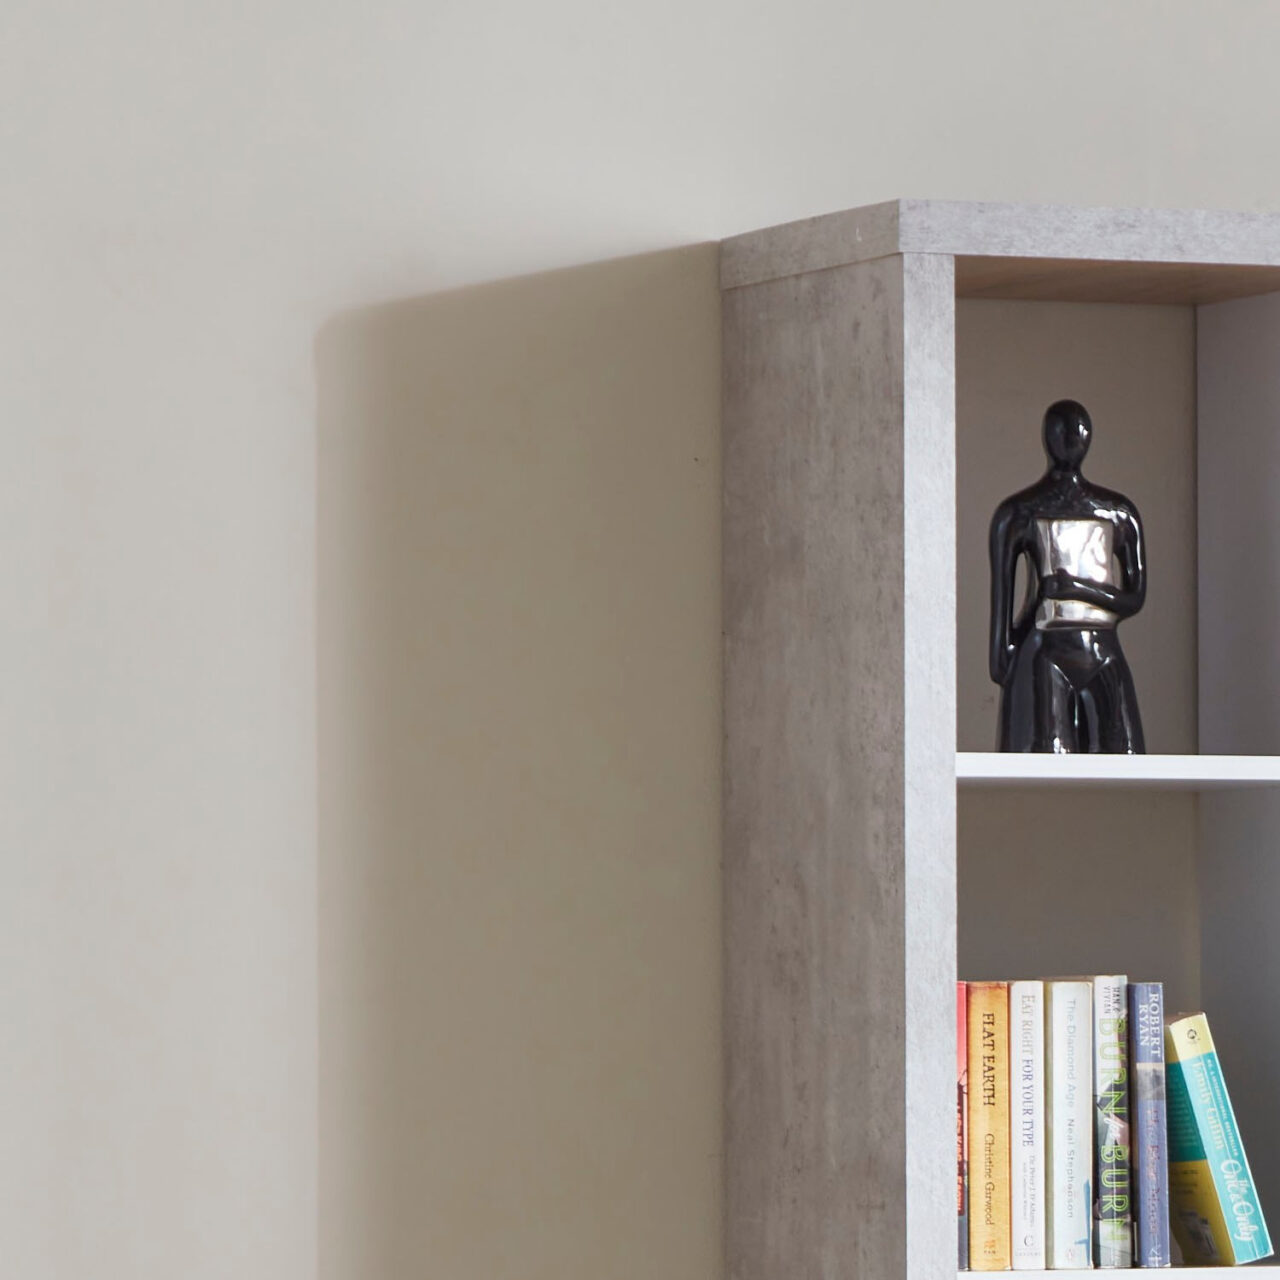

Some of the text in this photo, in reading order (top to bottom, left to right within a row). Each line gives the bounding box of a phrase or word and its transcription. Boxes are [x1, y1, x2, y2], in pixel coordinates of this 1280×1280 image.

[1022, 1019, 1035, 1055] RIGHT
[1139, 1005, 1150, 1046] RYAN
[1149, 993, 1161, 1058] ROBERT
[982, 1012, 996, 1106] FLAT EARTH
[1022, 1059, 1035, 1082] FOR
[1066, 999, 1077, 1108] The Diamond Age
[1098, 1018, 1128, 1115] BURN
[1022, 1085, 1034, 1115] YOUR
[984, 1133, 996, 1178] Christine
[1022, 1119, 1034, 1147] TYPE
[1066, 1118, 1076, 1218] Neal Stephenson
[1101, 1145, 1129, 1241] BURN
